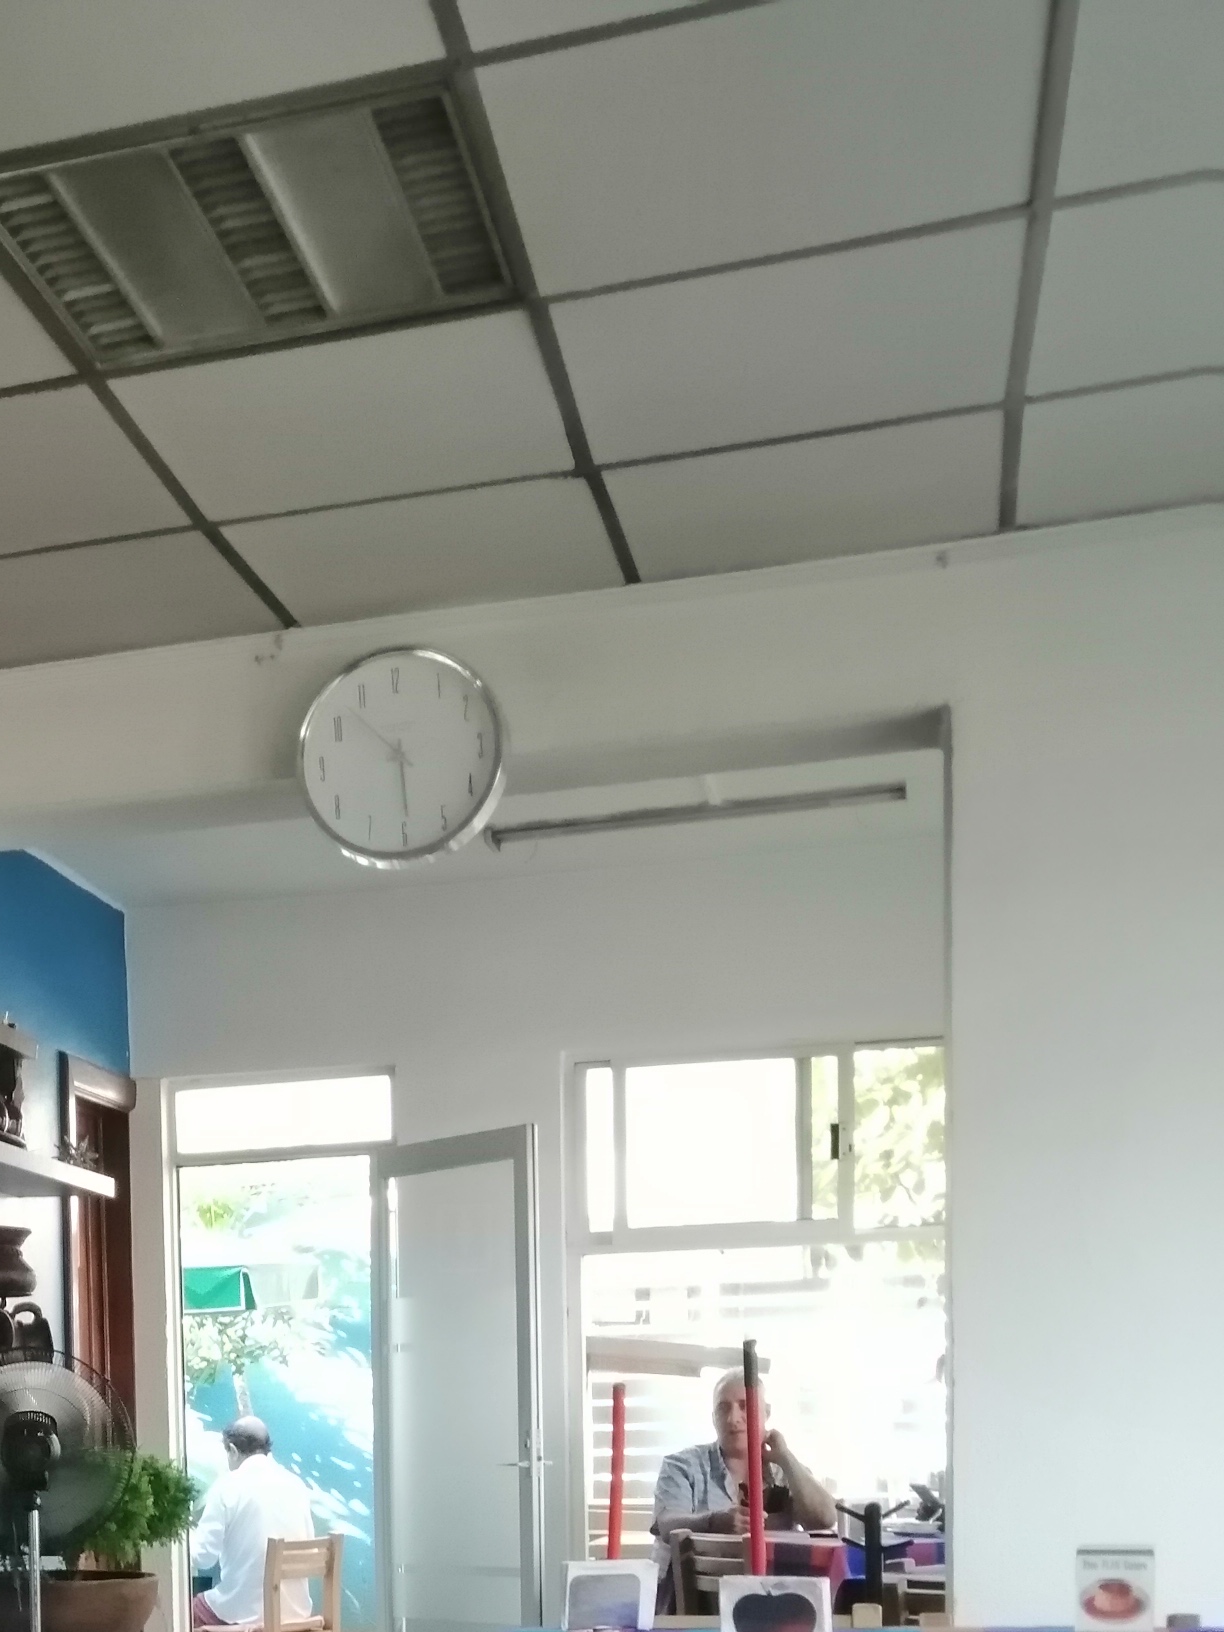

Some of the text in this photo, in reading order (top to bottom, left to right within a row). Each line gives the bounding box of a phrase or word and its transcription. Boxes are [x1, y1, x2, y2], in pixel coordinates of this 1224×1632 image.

[389, 667, 400, 694] 12
[357, 683, 366, 709] 11
[462, 693, 470, 722] 2
[332, 715, 343, 743] 10
[318, 756, 326, 782] 9
[467, 772, 474, 797] 4
[333, 794, 341, 820] 8
[440, 804, 448, 832] 5
[401, 821, 408, 847] 6
